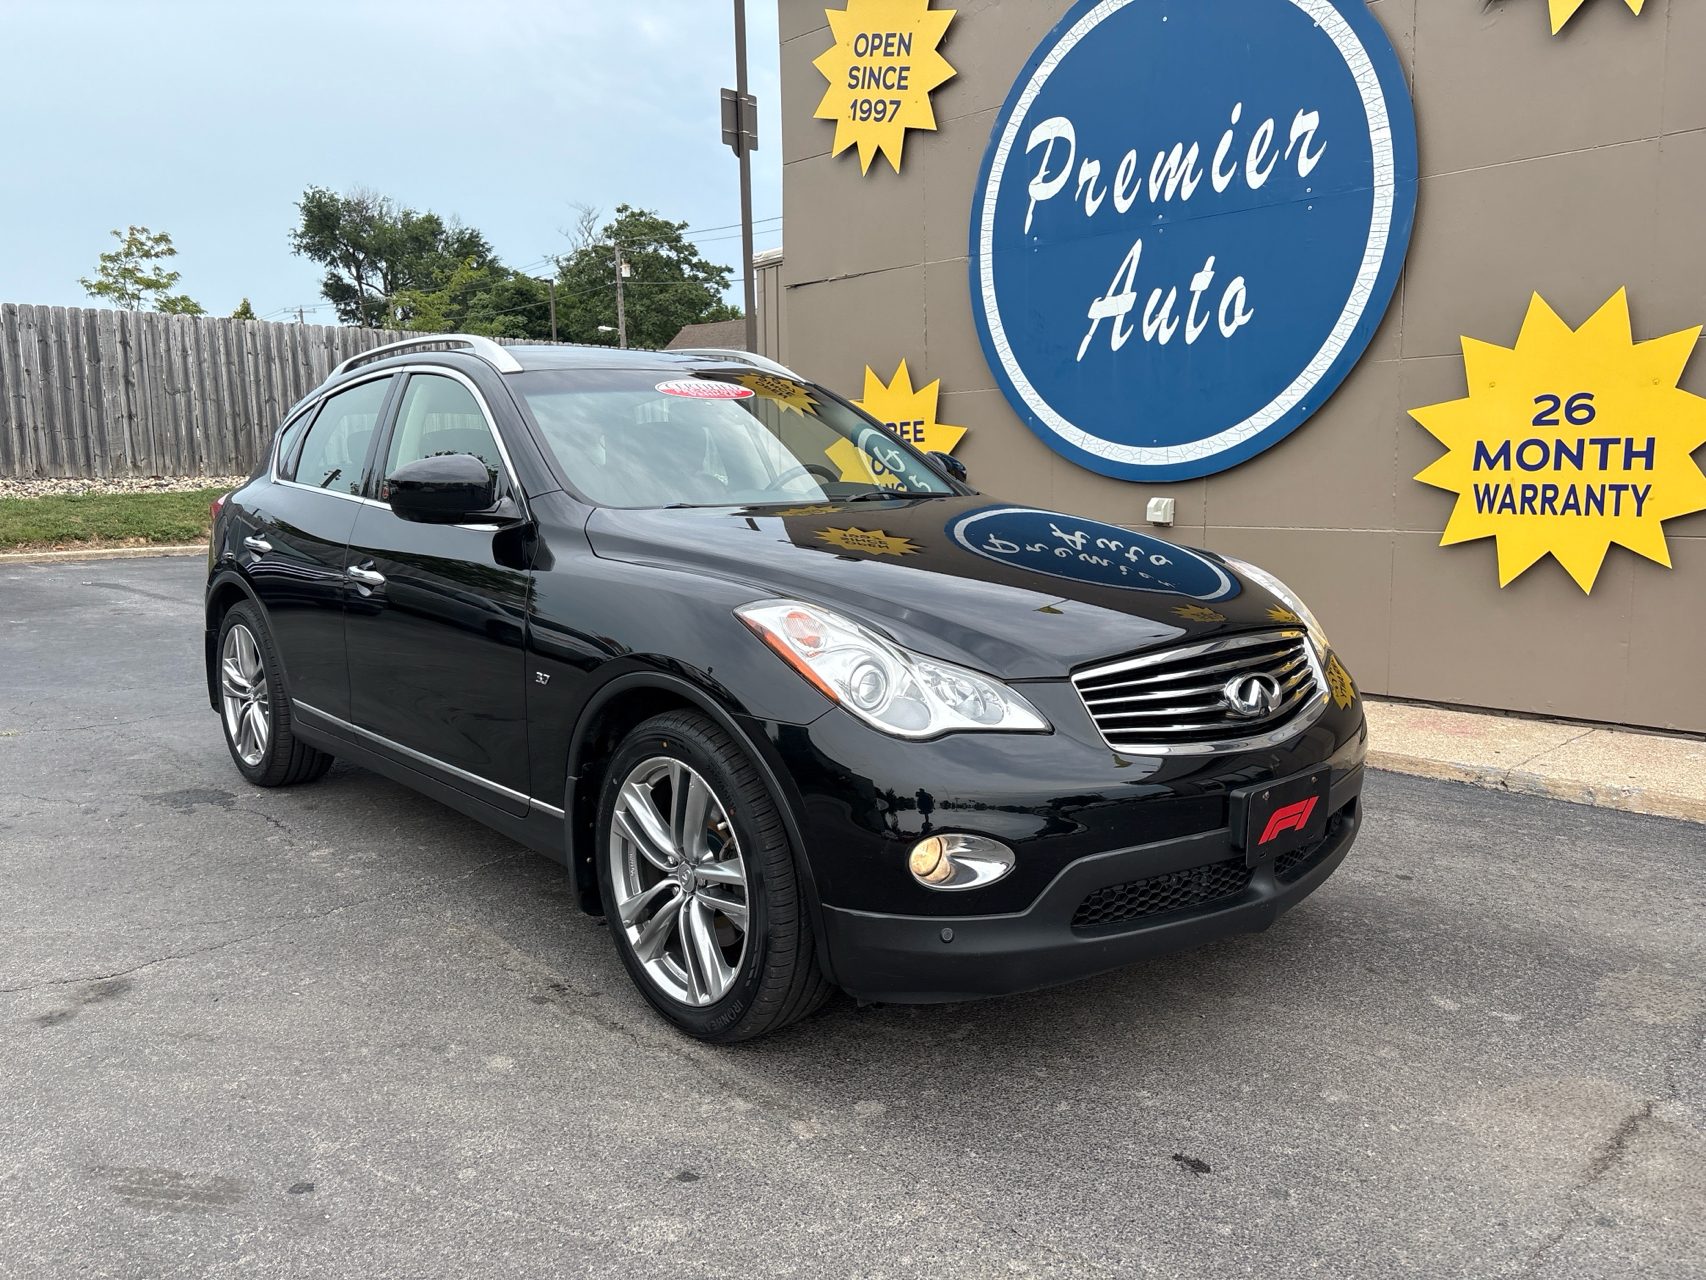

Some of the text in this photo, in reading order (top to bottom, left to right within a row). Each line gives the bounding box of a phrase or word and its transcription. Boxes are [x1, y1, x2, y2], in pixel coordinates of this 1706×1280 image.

[853, 32, 913, 57] OPEN
[847, 65, 911, 90] SINCE
[849, 98, 902, 123] 1997
[1024, 102, 1327, 235] Premier
[1076, 238, 1254, 362] Auto
[1532, 392, 1597, 426] 26
[1472, 437, 1656, 471] MONTH
[1473, 483, 1652, 517] WARRANTY
